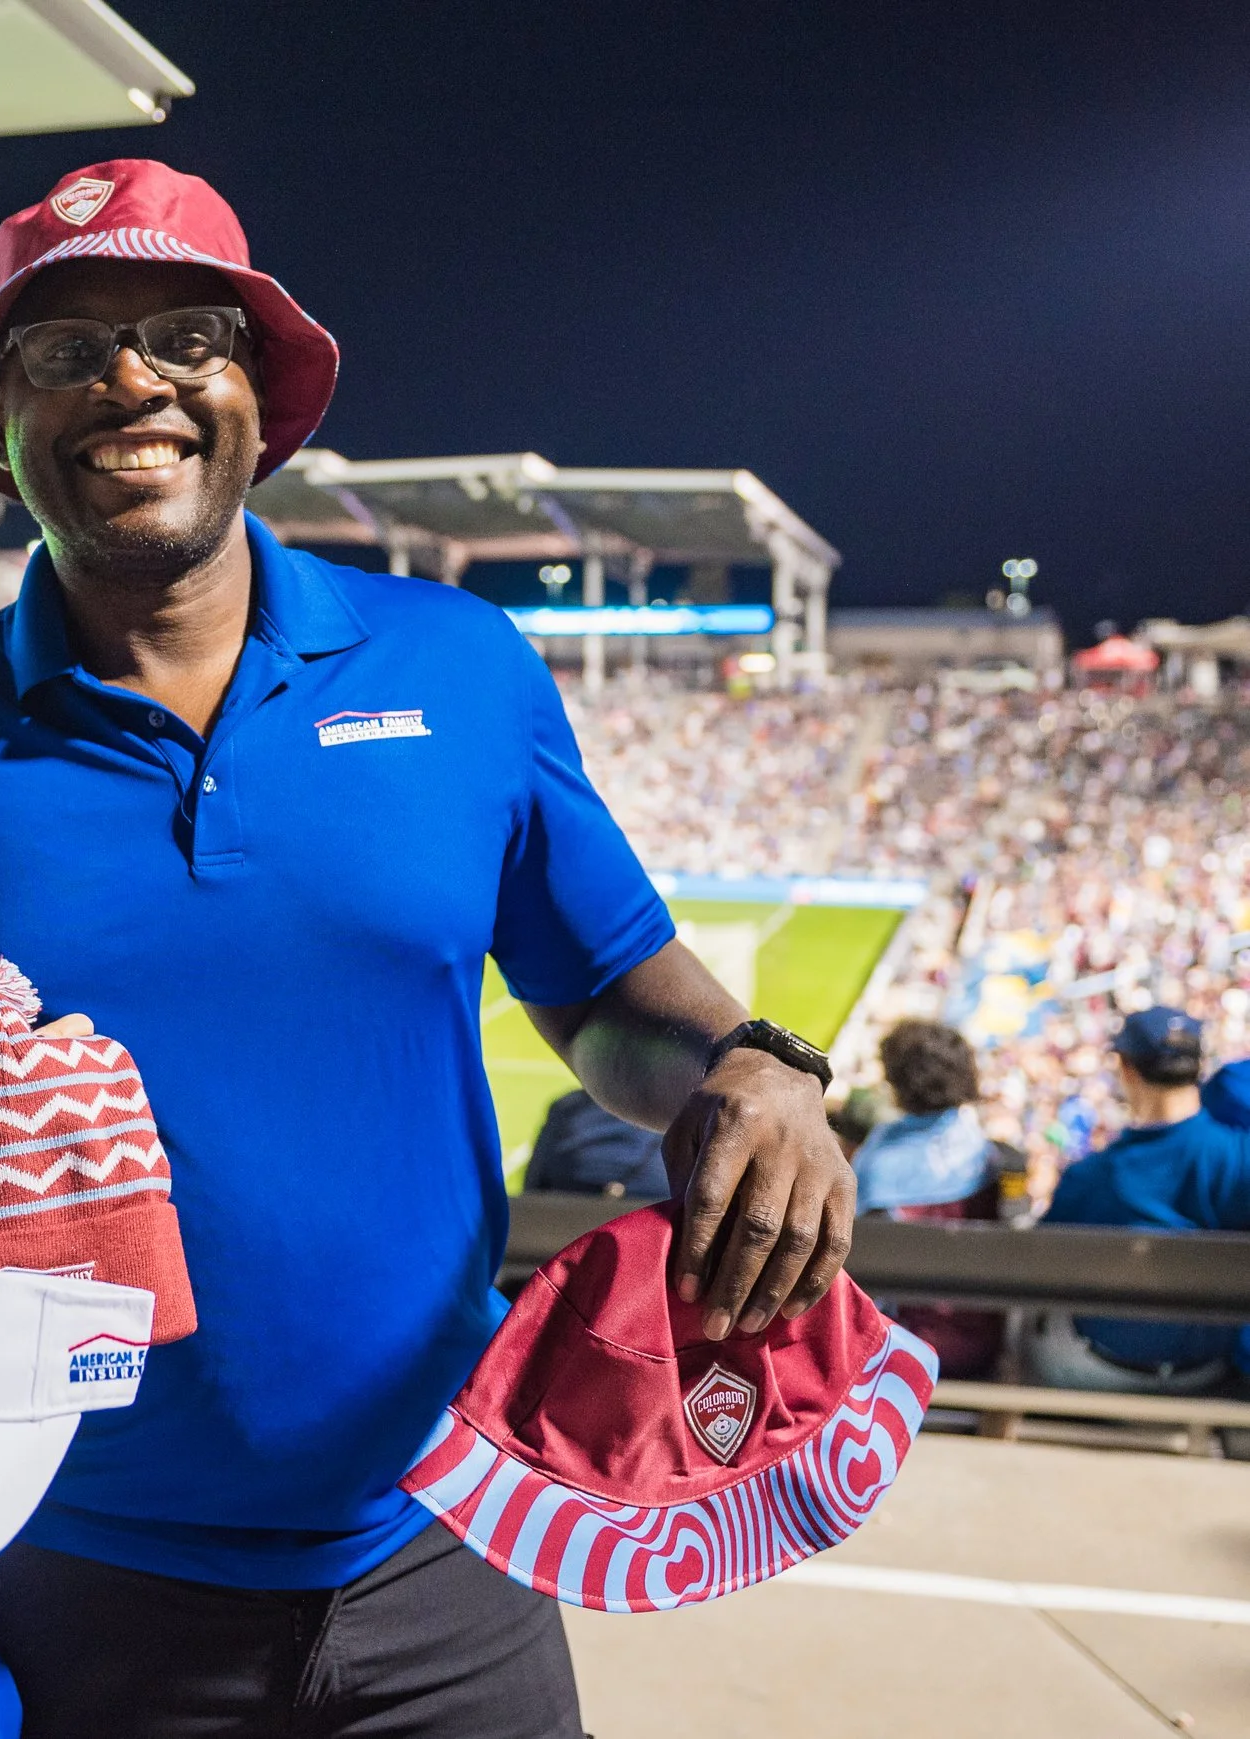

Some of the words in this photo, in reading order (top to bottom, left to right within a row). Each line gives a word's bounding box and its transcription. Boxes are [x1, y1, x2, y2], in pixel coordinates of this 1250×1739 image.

[319, 718, 380, 736] AMERICAN
[382, 715, 422, 728] FAMILY
[329, 728, 415, 742] INSURANCE
[70, 1351, 132, 1368] AMERICAN
[79, 1365, 143, 1380] INSURA
[697, 1391, 745, 1413] COLORADO
[707, 1403, 736, 1413] RAPIDS
